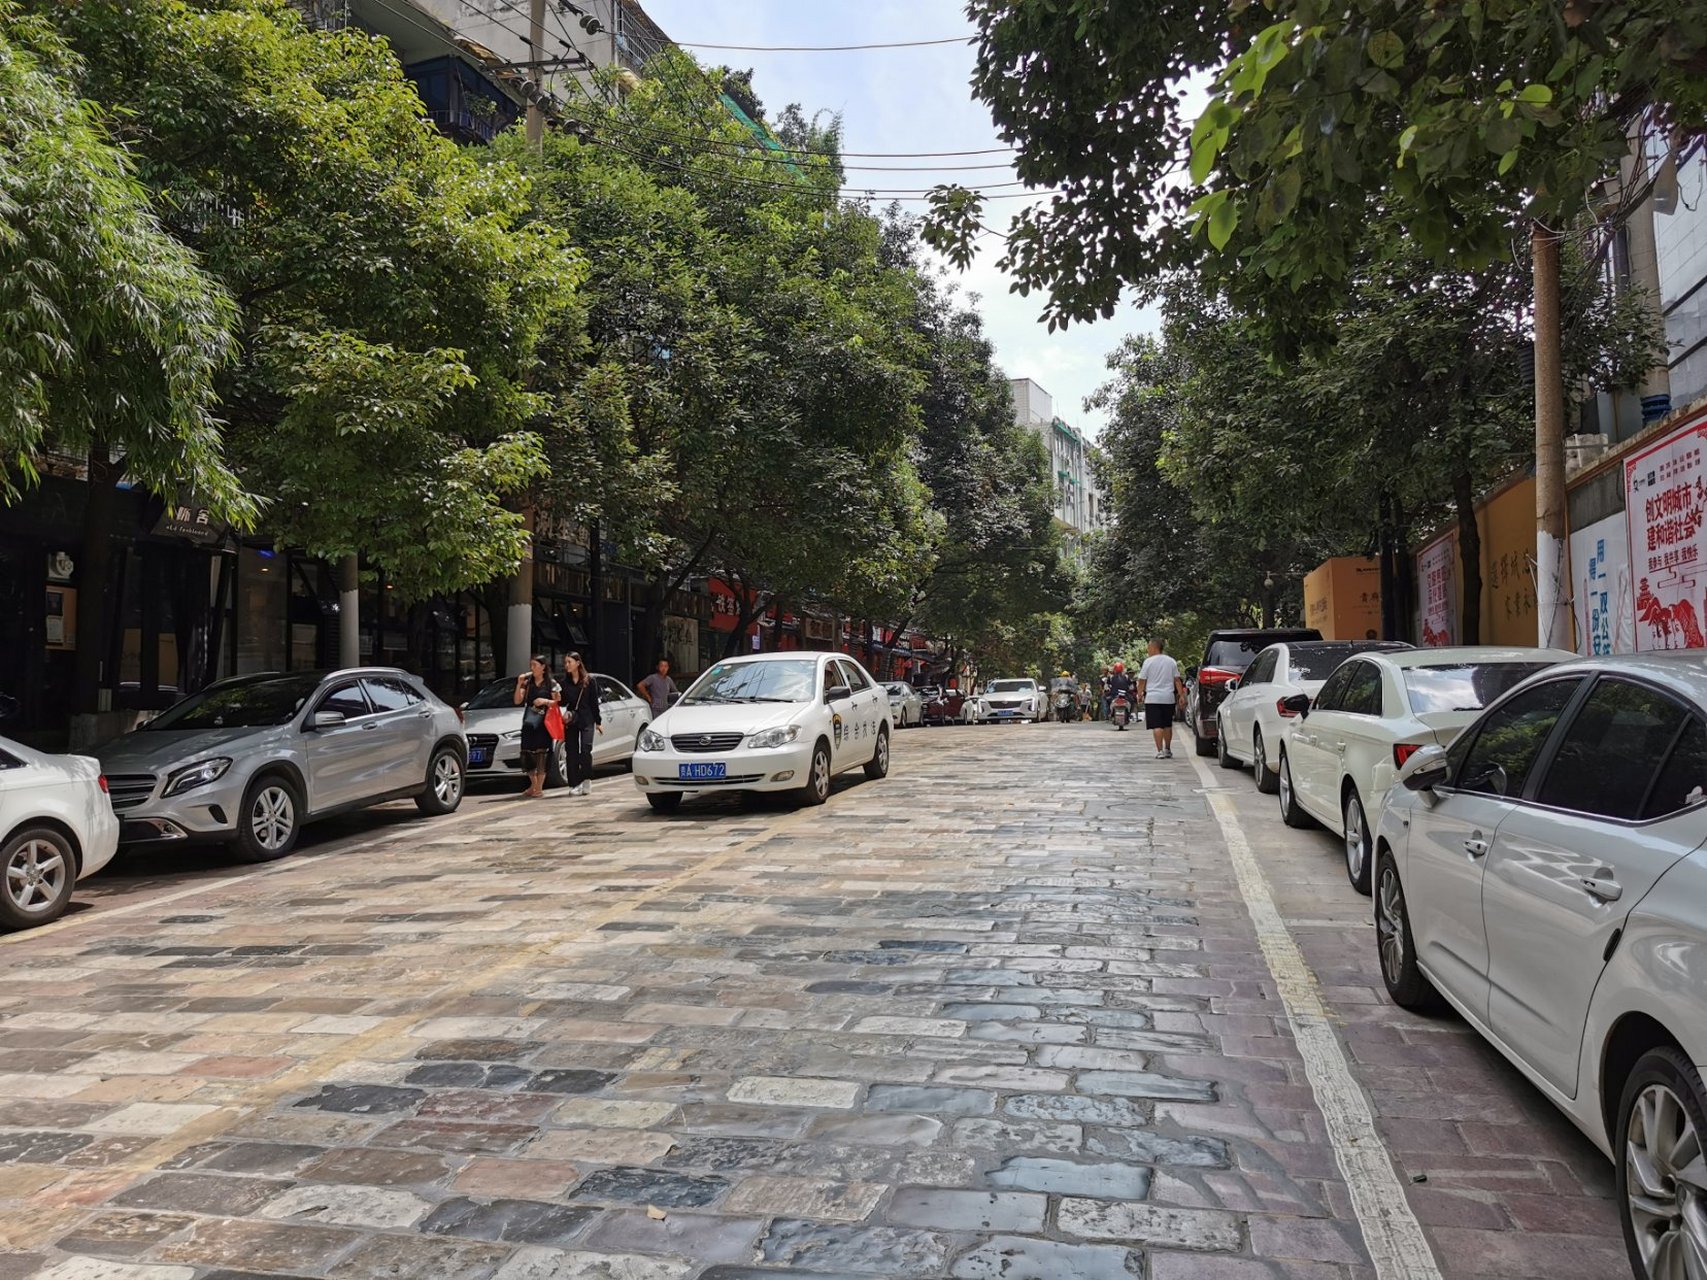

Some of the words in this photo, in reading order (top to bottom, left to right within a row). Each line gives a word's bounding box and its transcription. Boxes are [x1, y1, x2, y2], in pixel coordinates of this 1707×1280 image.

[1645, 482, 1692, 523] 创文明城市
[1647, 511, 1697, 552] 建和谐社会
